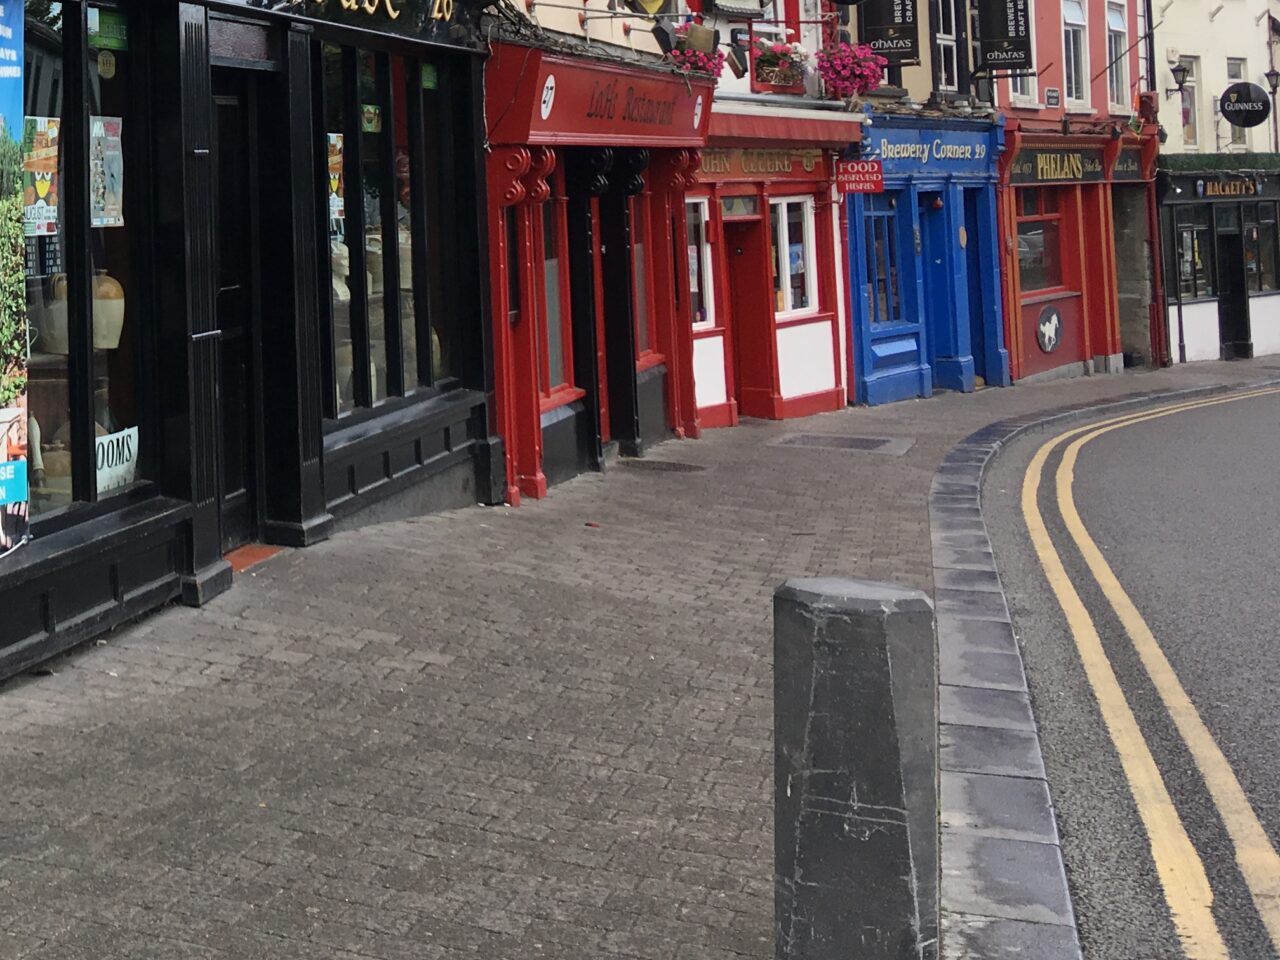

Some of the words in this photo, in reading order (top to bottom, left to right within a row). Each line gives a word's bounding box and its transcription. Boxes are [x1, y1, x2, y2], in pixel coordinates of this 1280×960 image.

[1018, 12, 1026, 36] CRAFT
[1225, 102, 1263, 111] GUINNESS
[881, 138, 930, 164] Brewery
[932, 139, 971, 159] Corner
[974, 144, 986, 159] 29
[839, 162, 878, 173] FOOD
[1036, 153, 1083, 179] PHELANS
[837, 173, 882, 181] SERVED
[846, 182, 875, 190] HERE
[1206, 180, 1255, 196] HACKETT'S
[96, 434, 132, 471] OOMS
